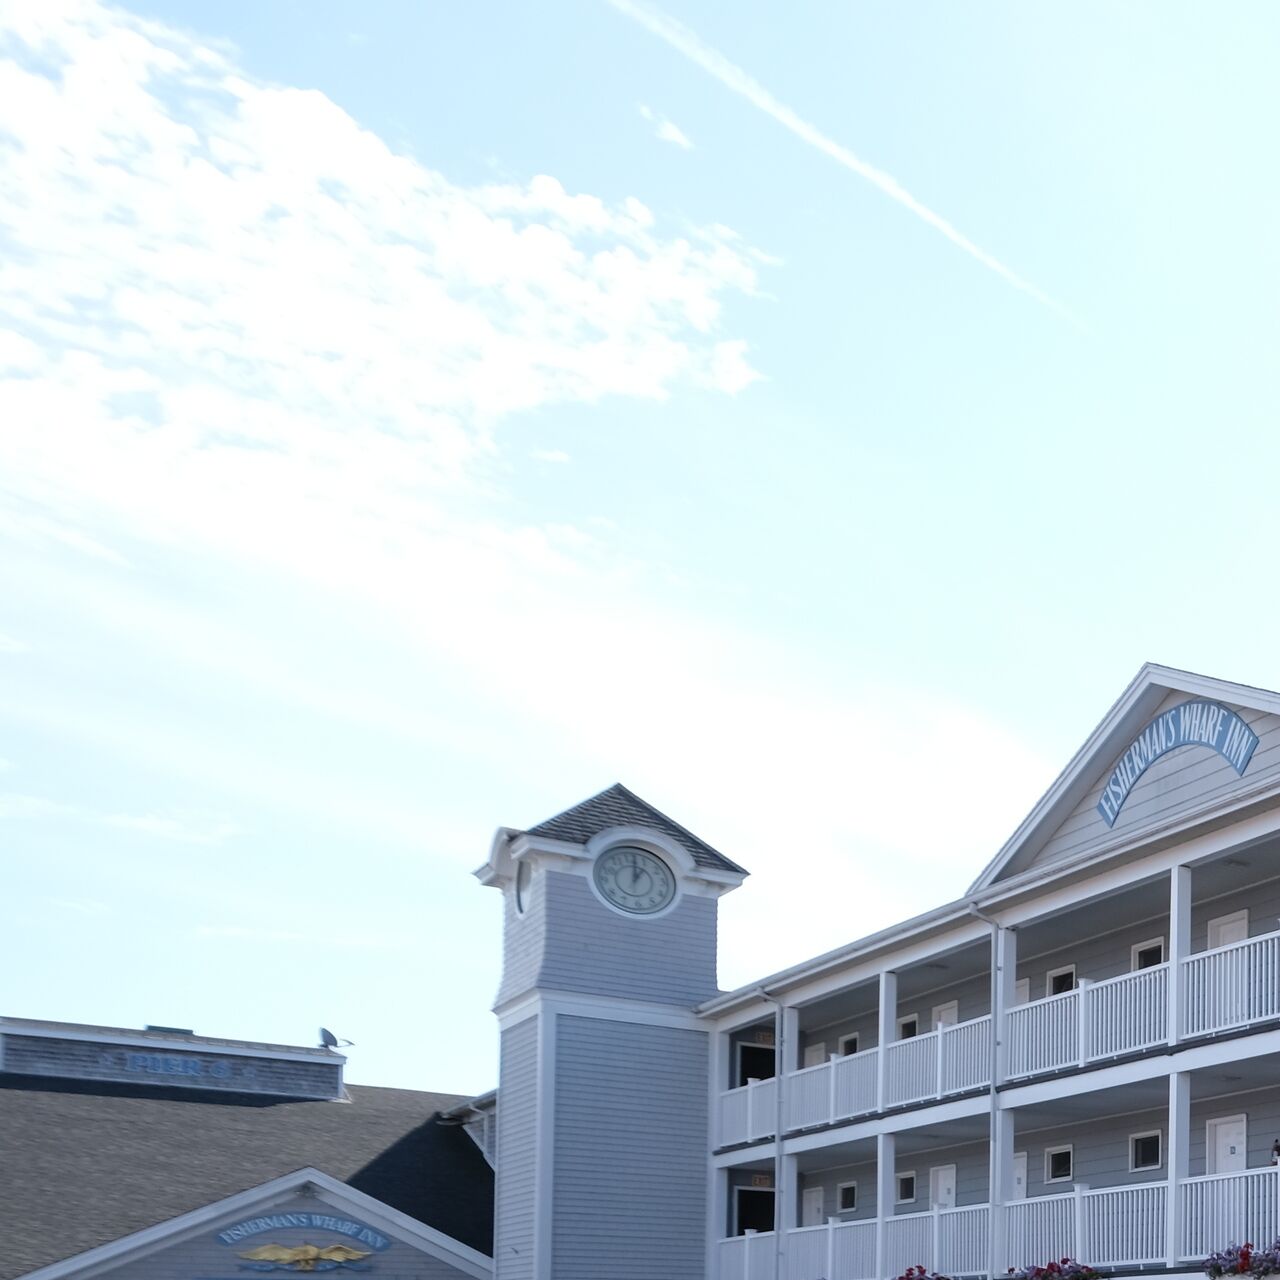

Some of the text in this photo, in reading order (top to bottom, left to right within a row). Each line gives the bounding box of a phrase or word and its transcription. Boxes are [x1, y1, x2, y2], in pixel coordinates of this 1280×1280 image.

[1100, 703, 1253, 822] FISHERMAN'S WHARF INN
[124, 1053, 232, 1078] PIER 6
[218, 1214, 388, 1248] FISHERMAN'S WHARF INN
